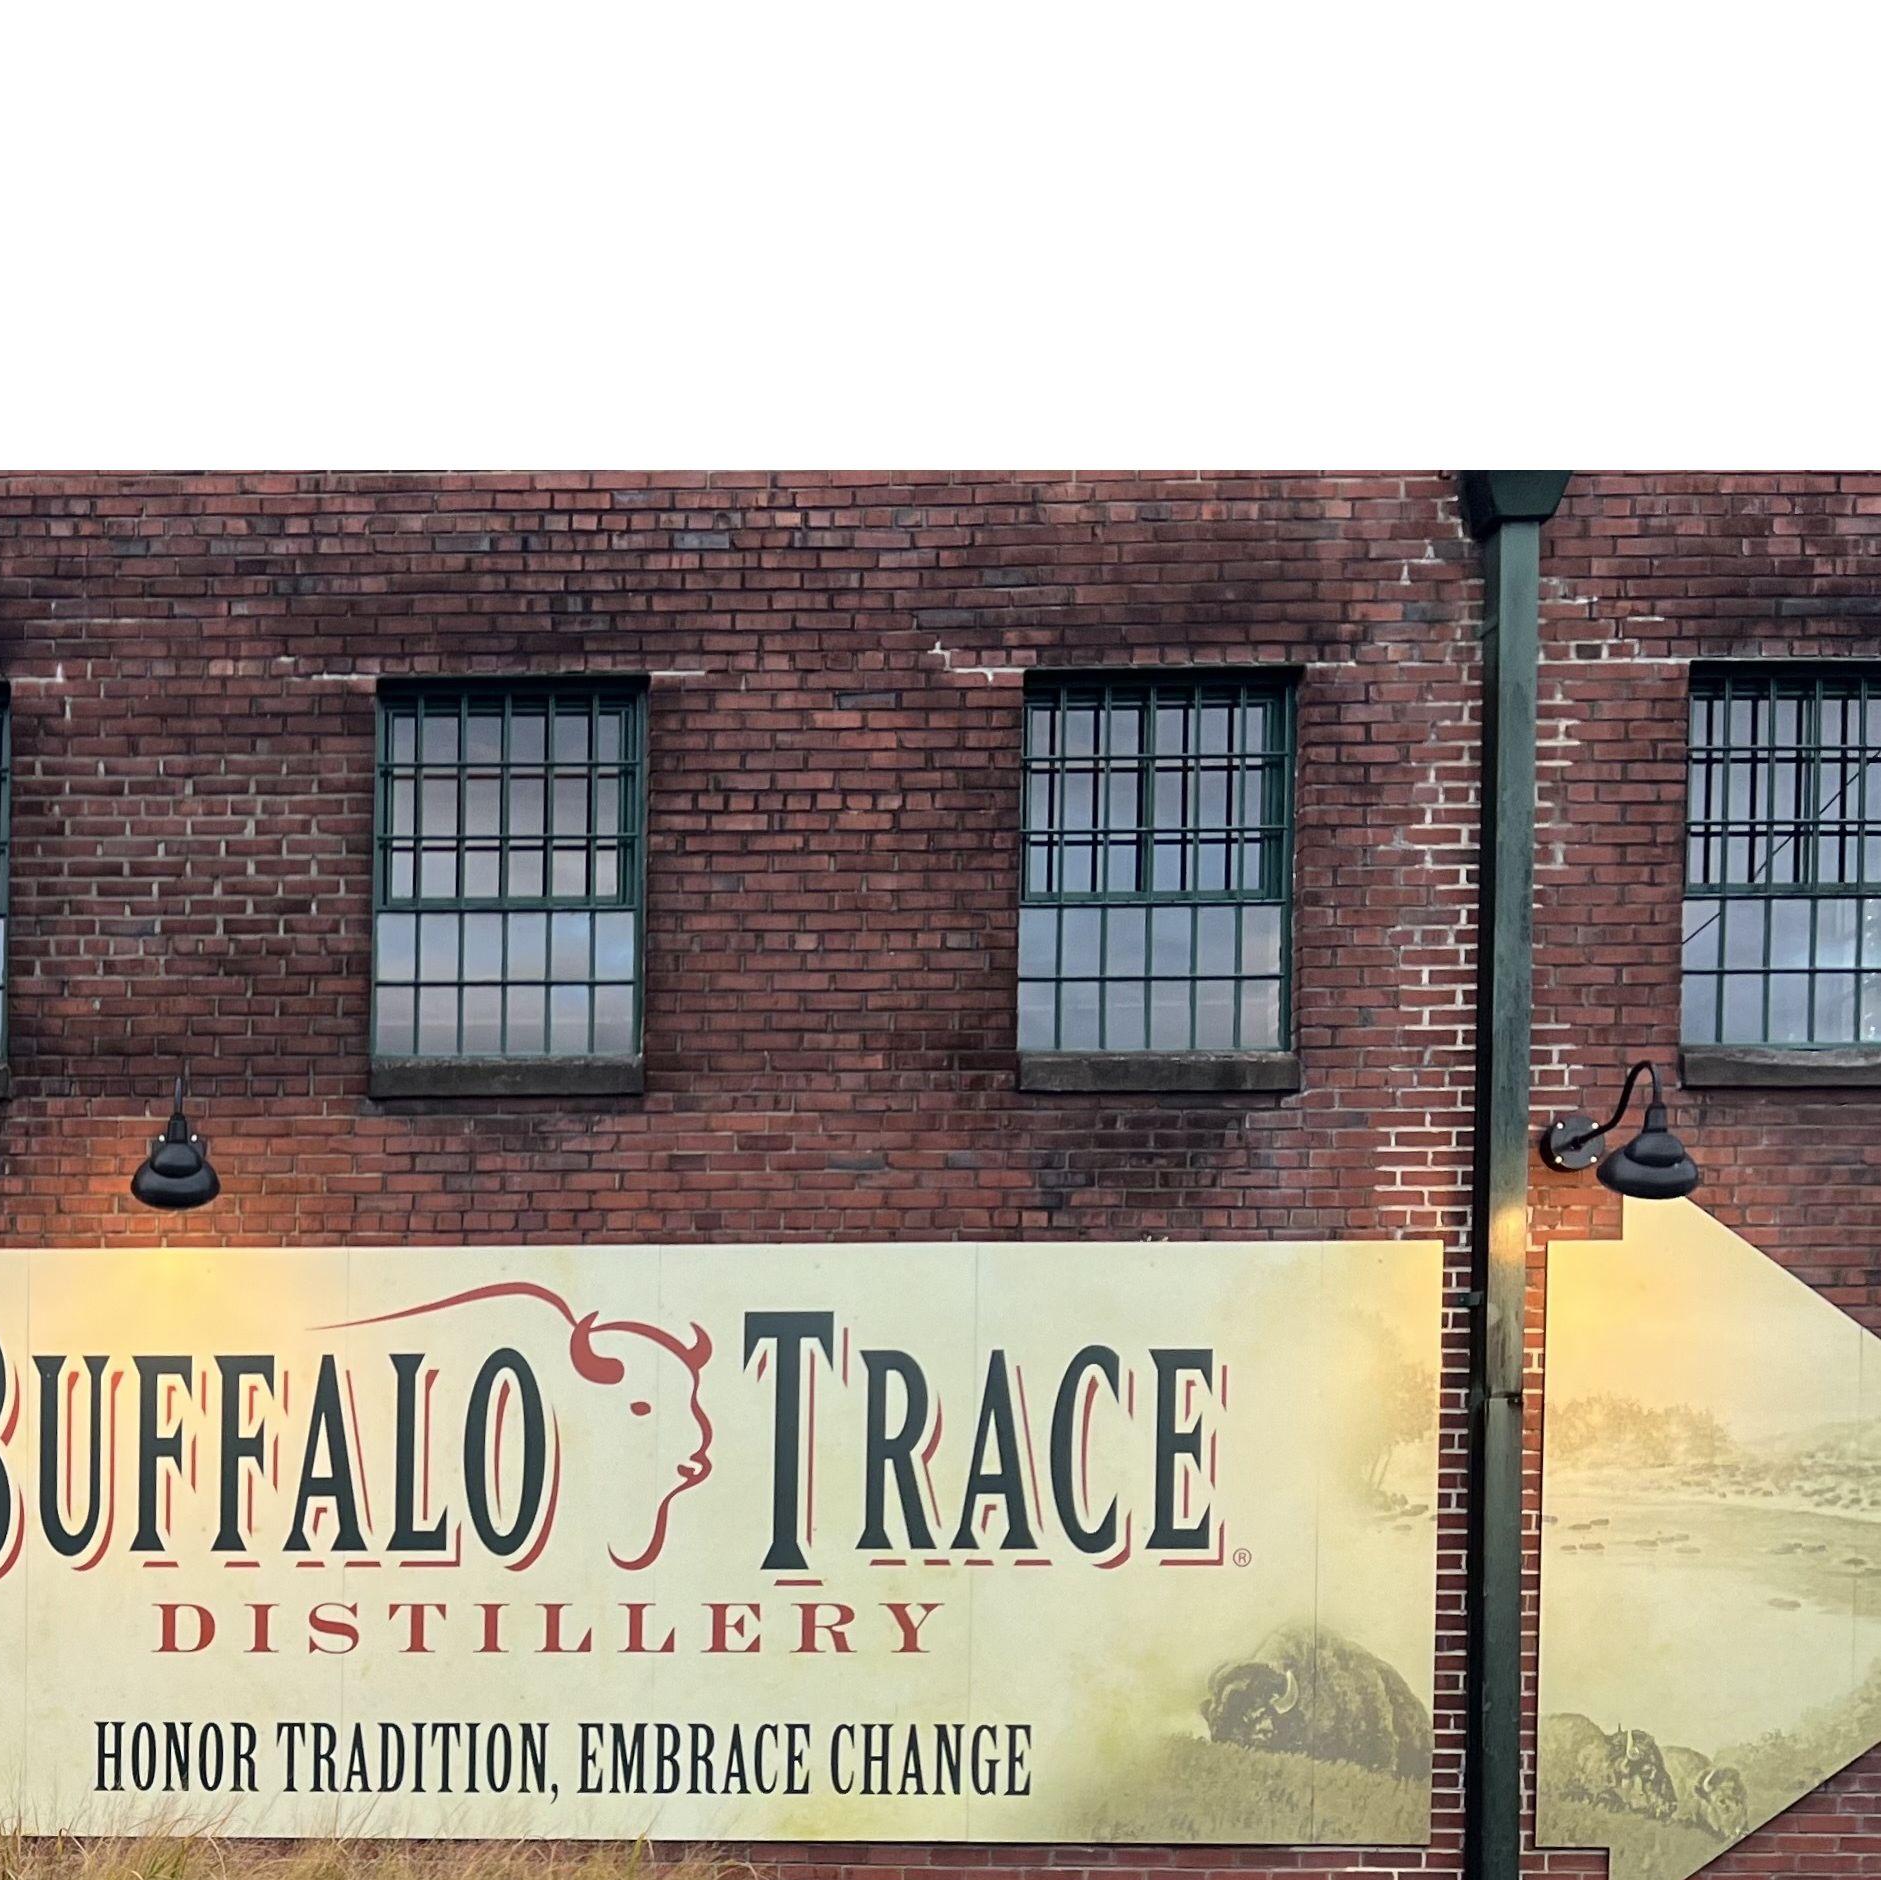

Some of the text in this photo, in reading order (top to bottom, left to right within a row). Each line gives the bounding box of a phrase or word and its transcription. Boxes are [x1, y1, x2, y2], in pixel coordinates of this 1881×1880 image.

[742, 1310, 1229, 1587] TRACE
[153, 1602, 944, 1654] DISTILLERY
[94, 1721, 1034, 1805] HONOR TRADITION, EMBRACE CHANGE
